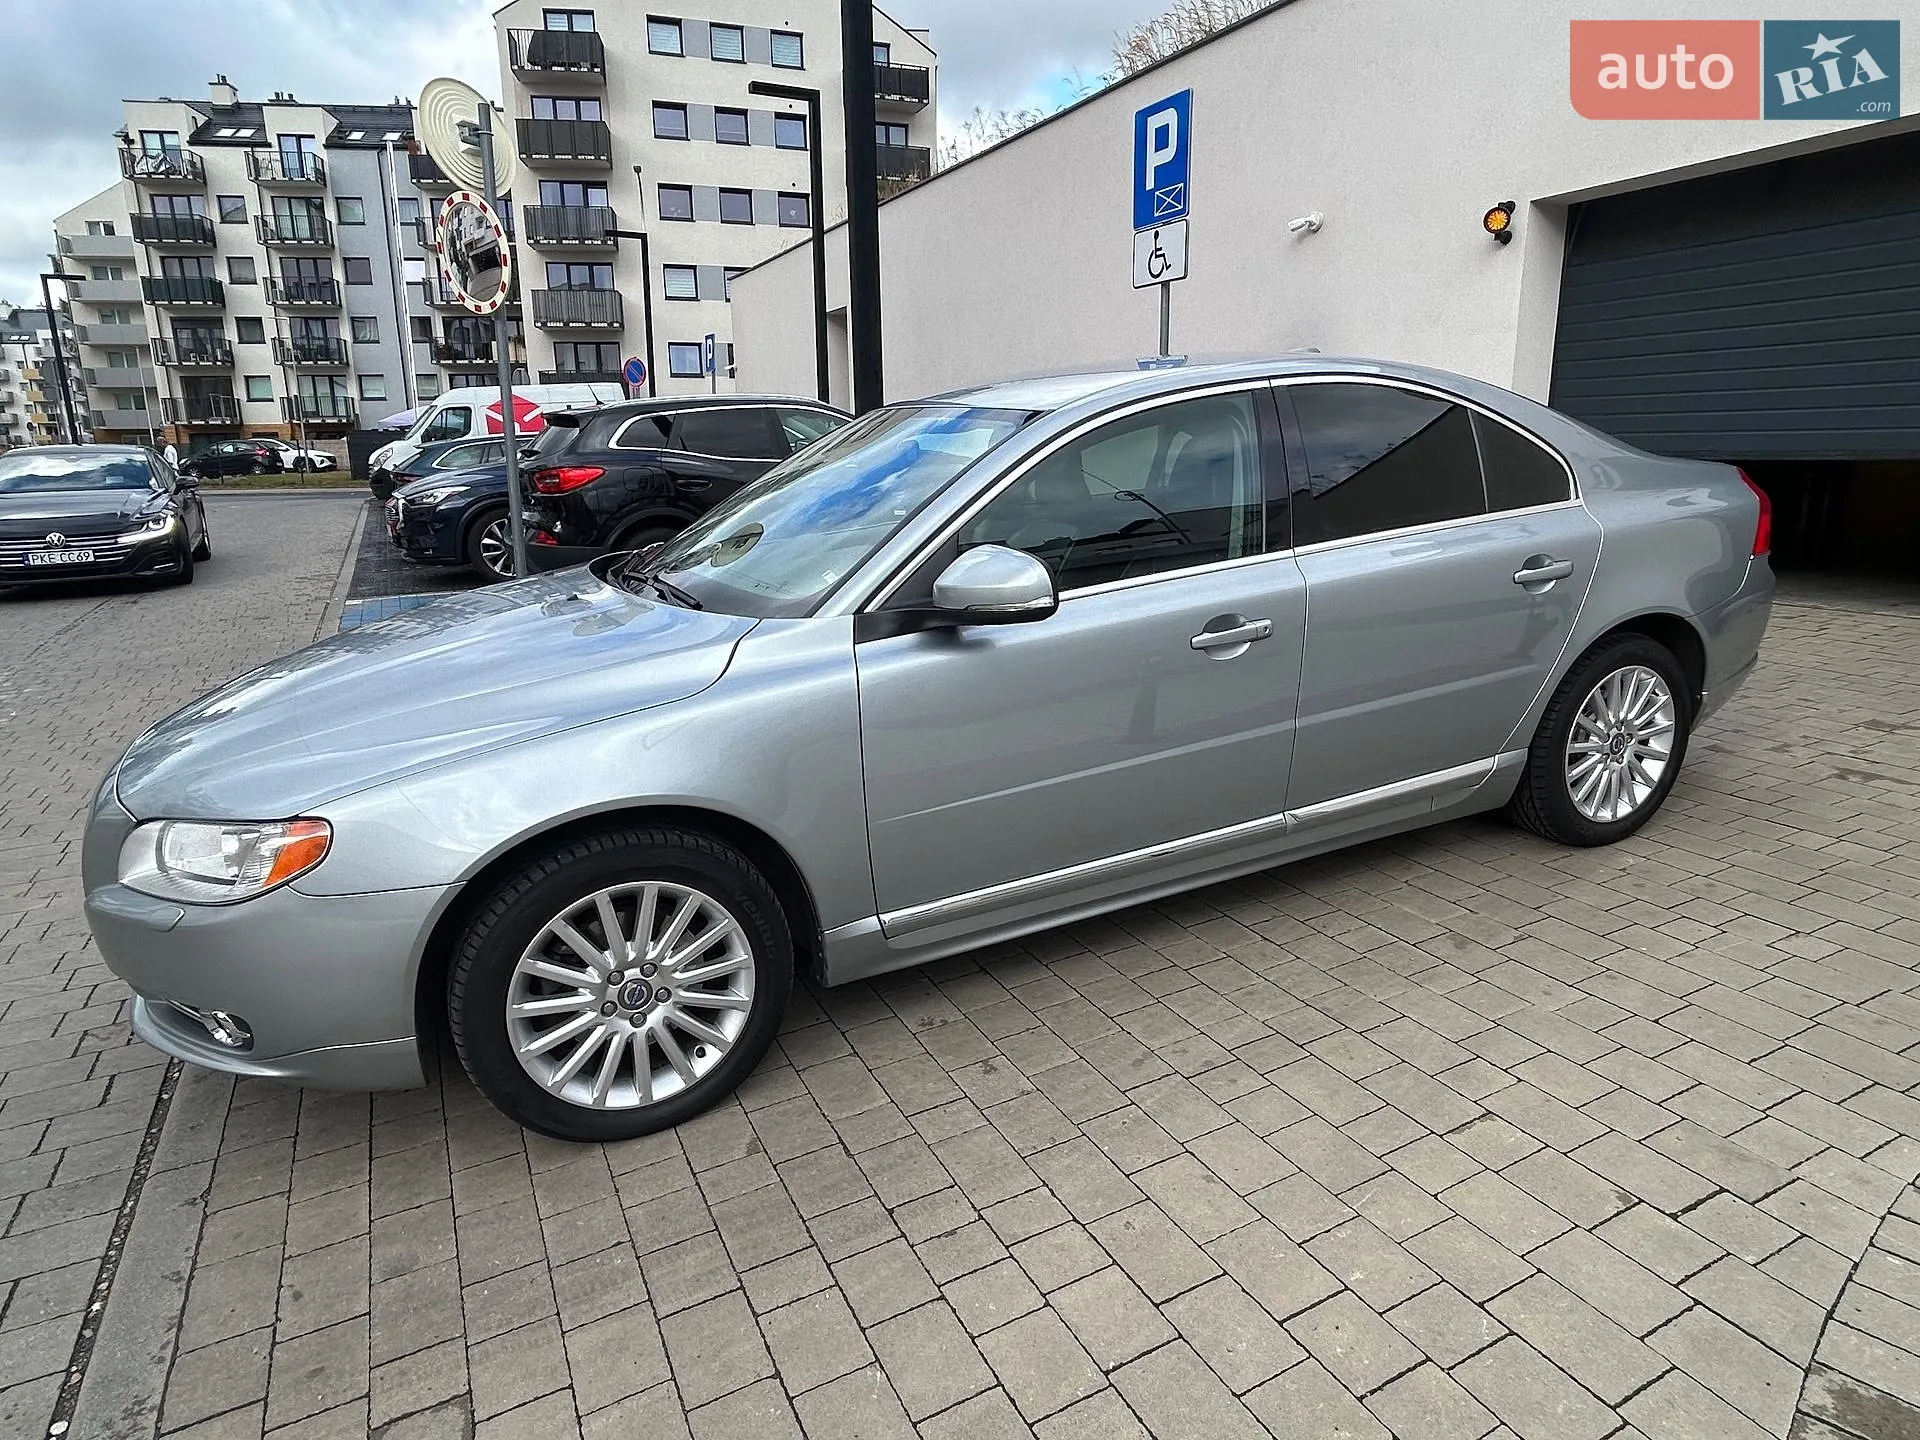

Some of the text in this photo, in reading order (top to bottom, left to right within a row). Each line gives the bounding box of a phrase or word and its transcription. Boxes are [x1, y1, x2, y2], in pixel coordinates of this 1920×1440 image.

[1146, 107, 1178, 191] P
[706, 338, 713, 368] P
[60, 551, 90, 563] CC69
